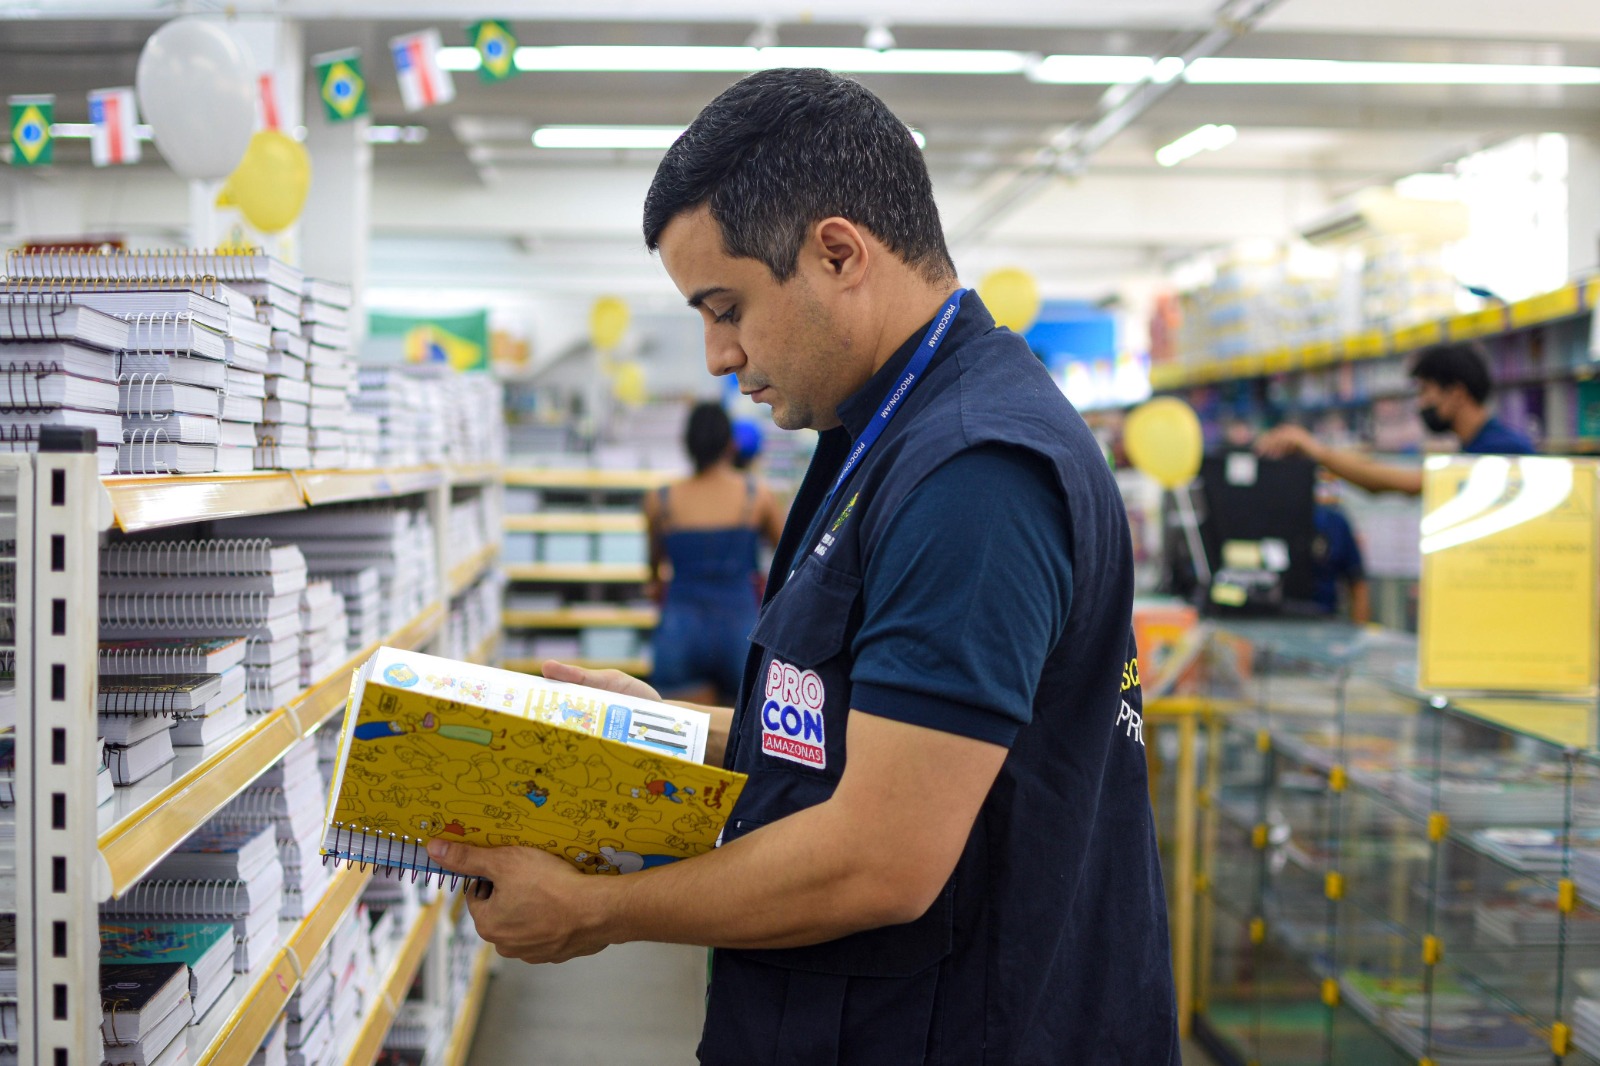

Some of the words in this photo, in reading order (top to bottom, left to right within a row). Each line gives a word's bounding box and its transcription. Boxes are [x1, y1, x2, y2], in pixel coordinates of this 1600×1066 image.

[928, 304, 956, 348] PROCON/AM
[880, 373, 915, 419] PROCON/AM
[766, 662, 823, 710] PRO
[763, 700, 823, 744] CON
[765, 738, 822, 761] AMAZONAS
